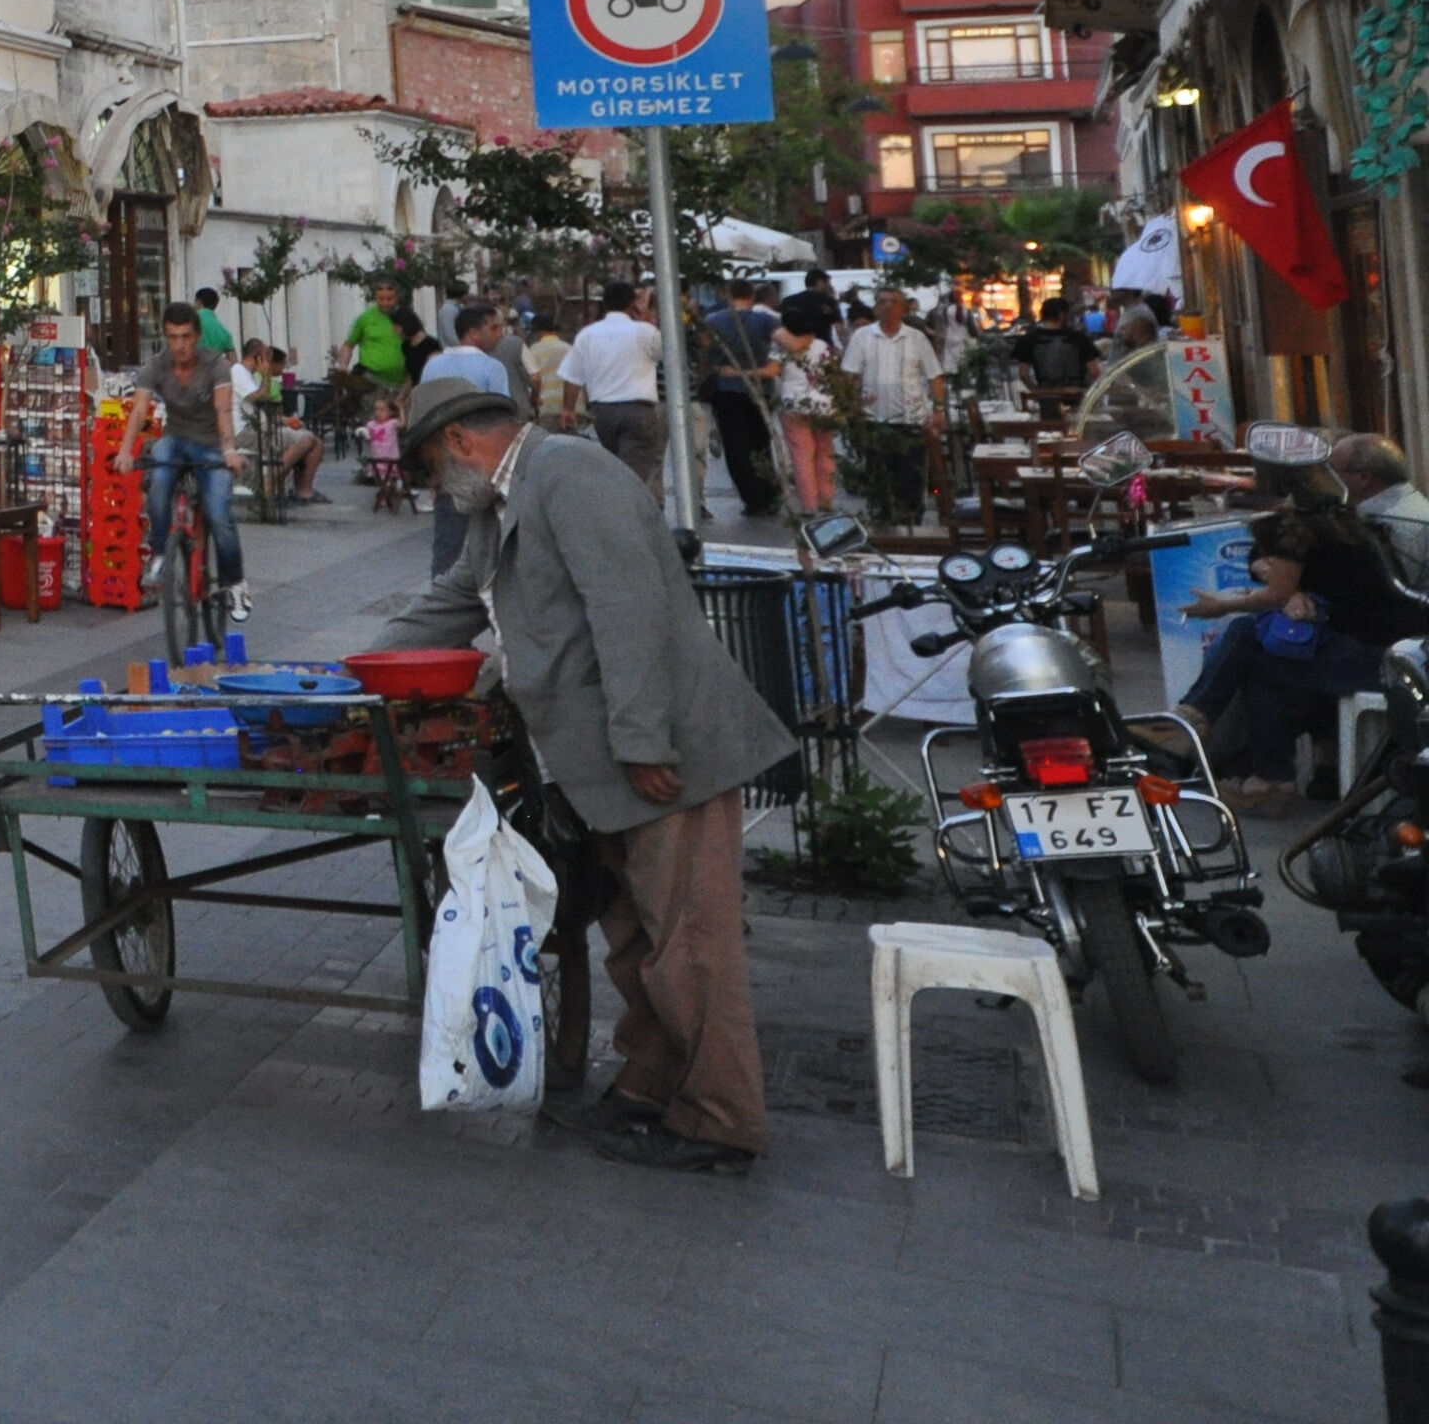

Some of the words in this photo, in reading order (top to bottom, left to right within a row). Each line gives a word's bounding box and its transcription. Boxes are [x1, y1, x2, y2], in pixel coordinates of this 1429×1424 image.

[556, 70, 745, 96] MOTORSİKLET
[590, 95, 713, 119] GİREMEZ
[1020, 800, 1058, 824] 17
[1086, 795, 1135, 819] FZ
[1050, 826, 1118, 850] 649
